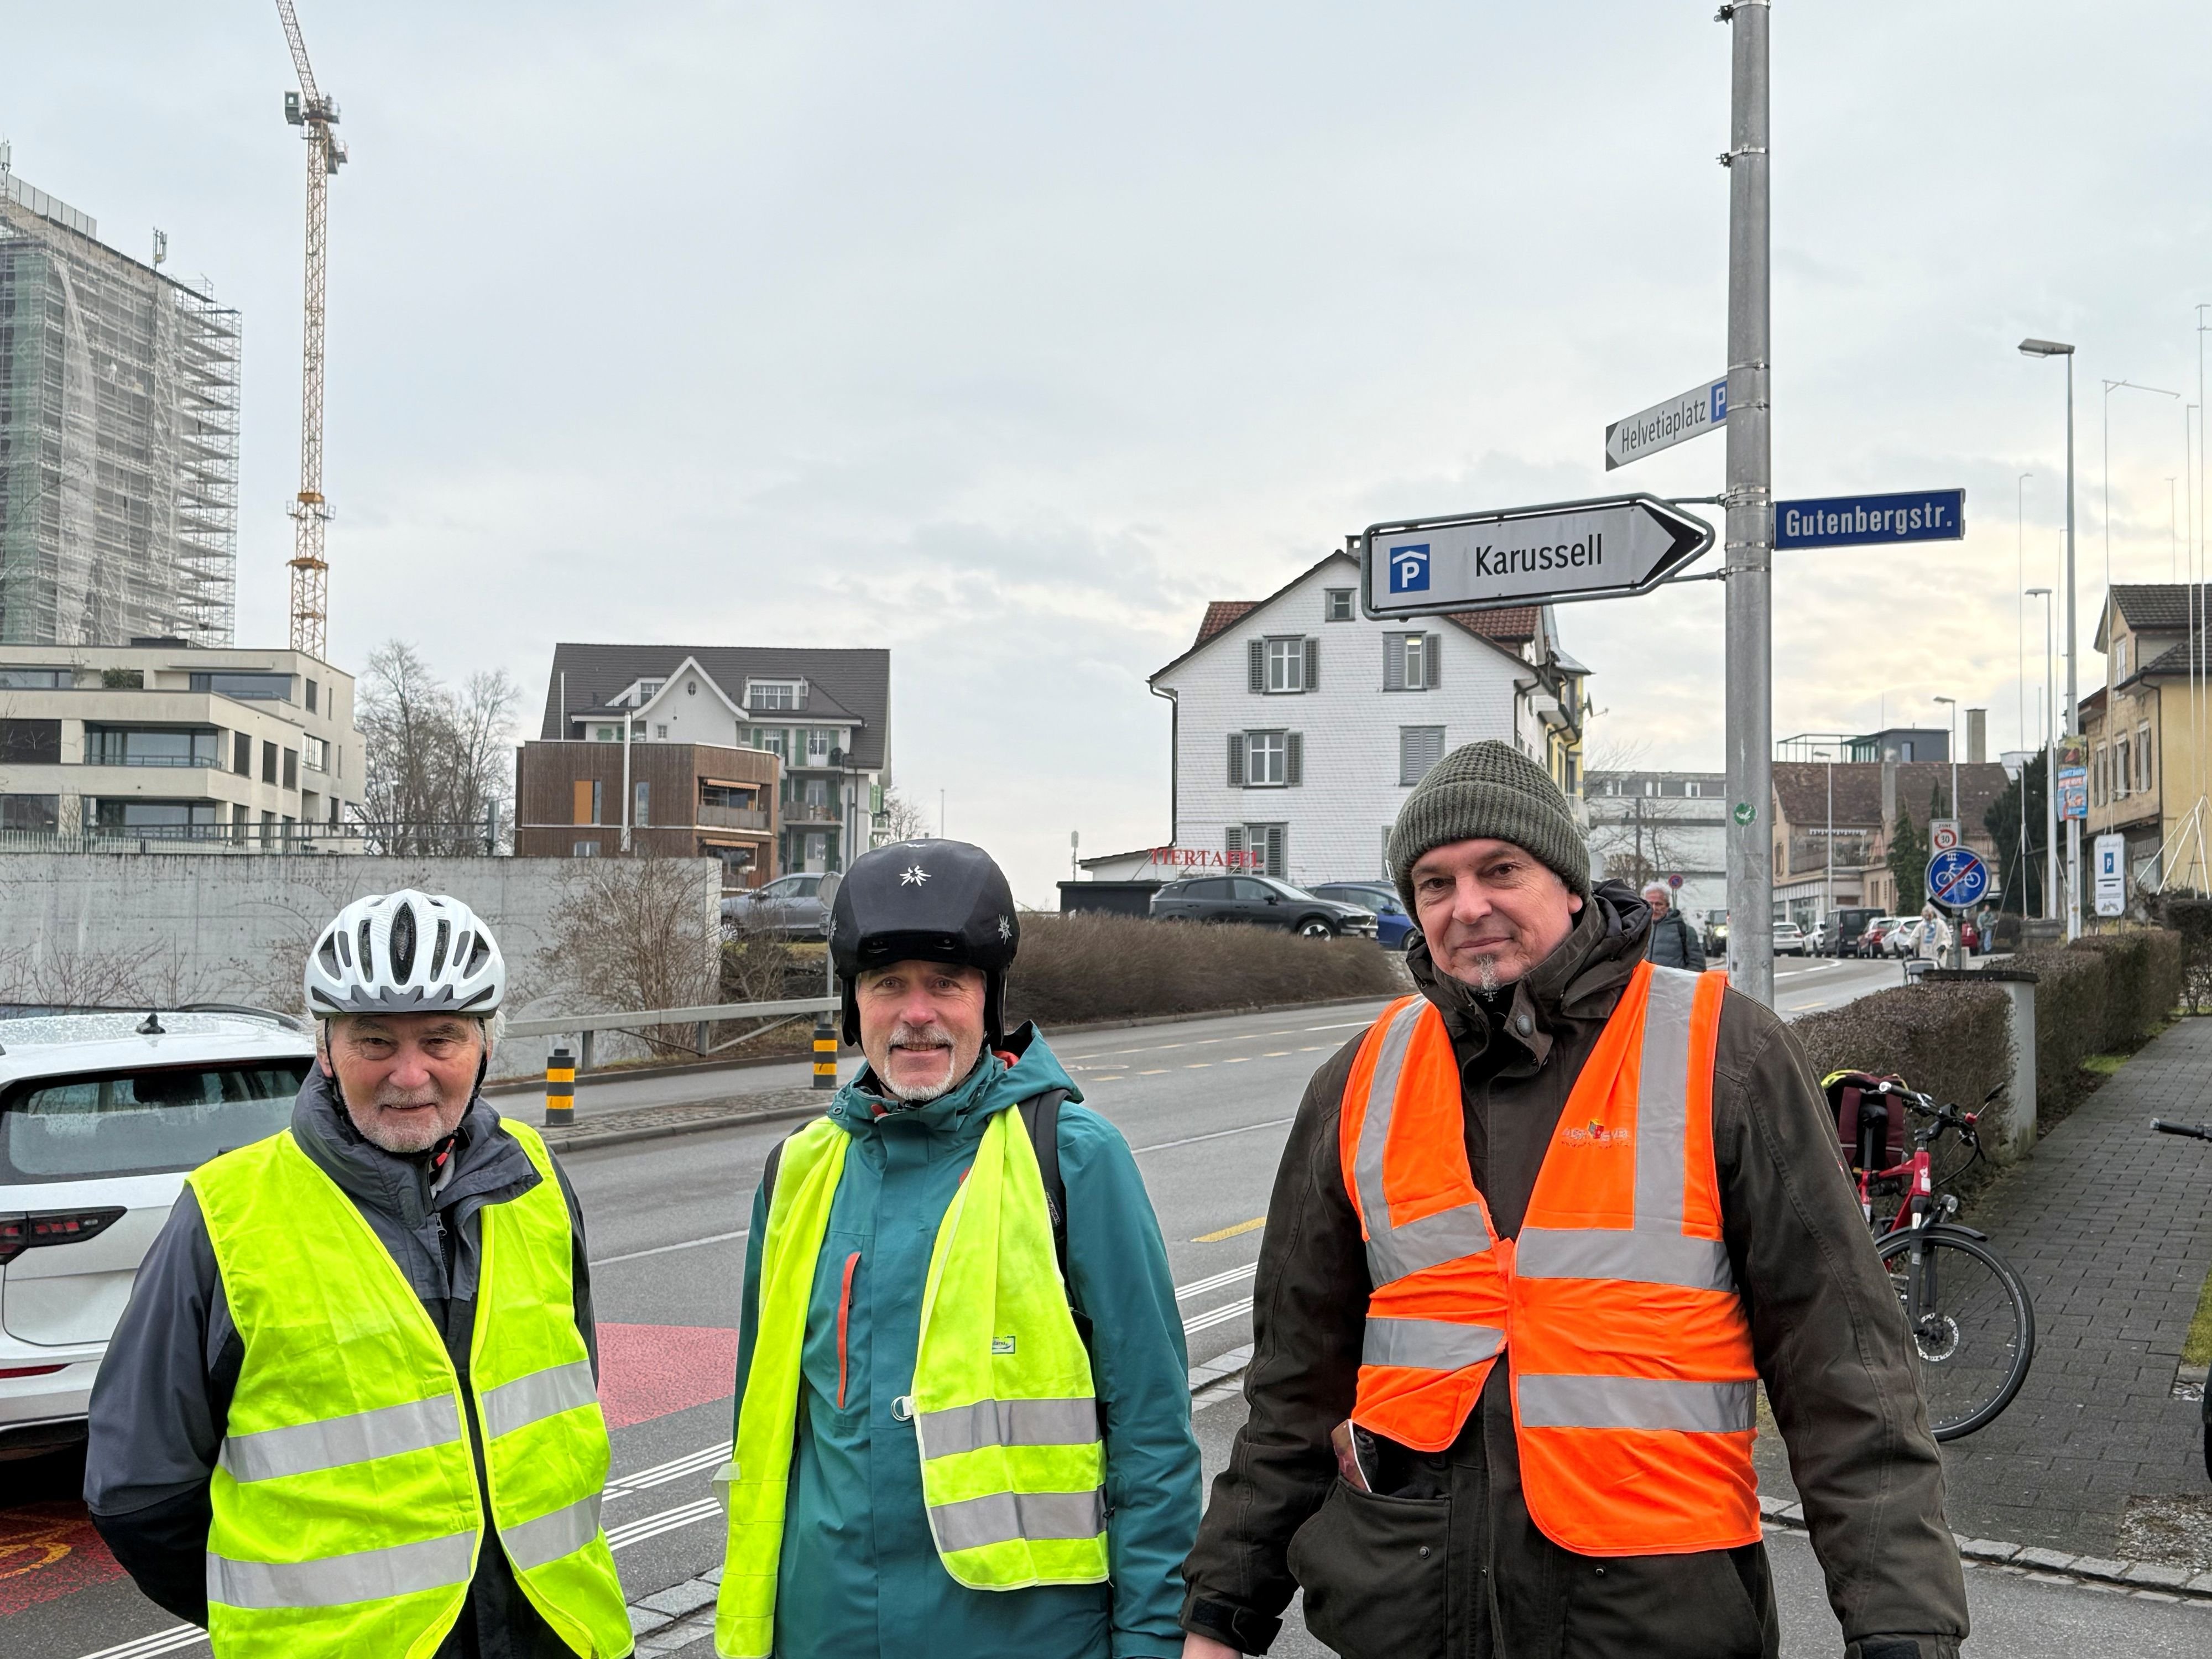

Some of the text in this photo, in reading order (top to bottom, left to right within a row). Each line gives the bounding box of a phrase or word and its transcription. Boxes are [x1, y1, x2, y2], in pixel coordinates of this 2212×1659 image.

[1621, 387, 1726, 454] Helvetiaplatz P
[1786, 502, 1953, 538] Gutenbergstr.
[1401, 533, 1602, 588] P Karussell
[1941, 835, 1950, 844] 30
[1147, 848, 1265, 868] TIERTAFEL
